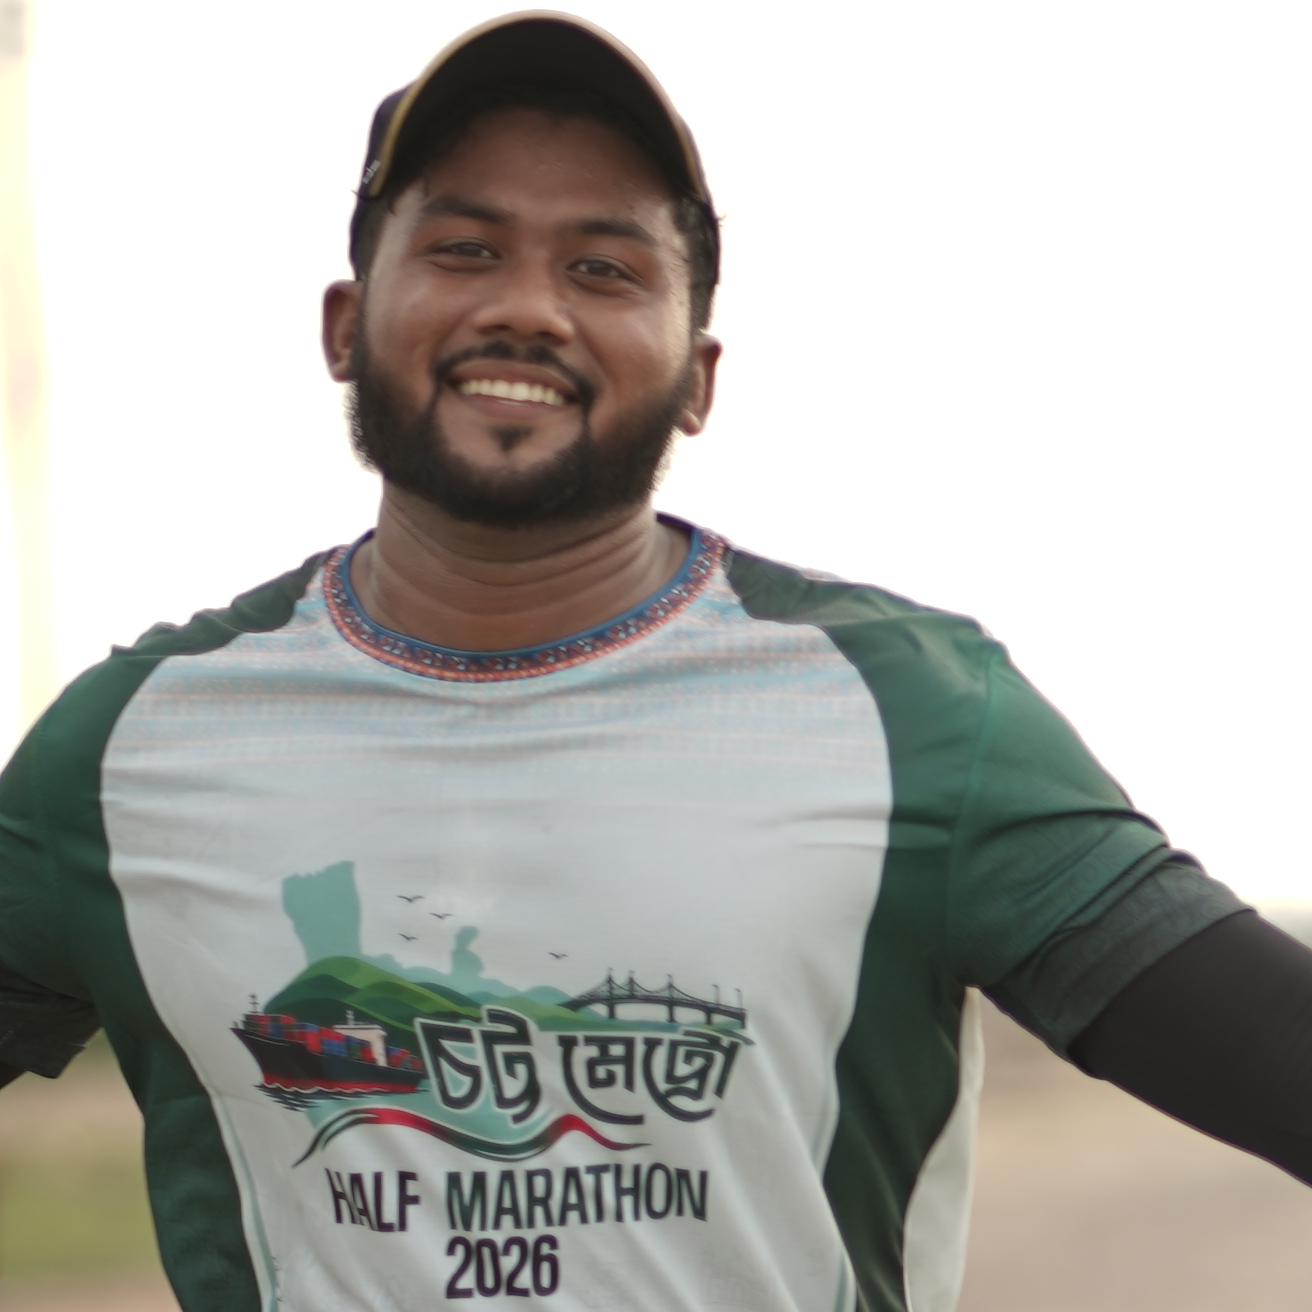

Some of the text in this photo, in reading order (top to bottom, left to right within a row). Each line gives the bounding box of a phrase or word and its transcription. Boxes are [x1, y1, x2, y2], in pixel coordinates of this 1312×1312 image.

[324, 1162, 708, 1233] HALF MARATHON
[446, 1234, 560, 1299] 2026
